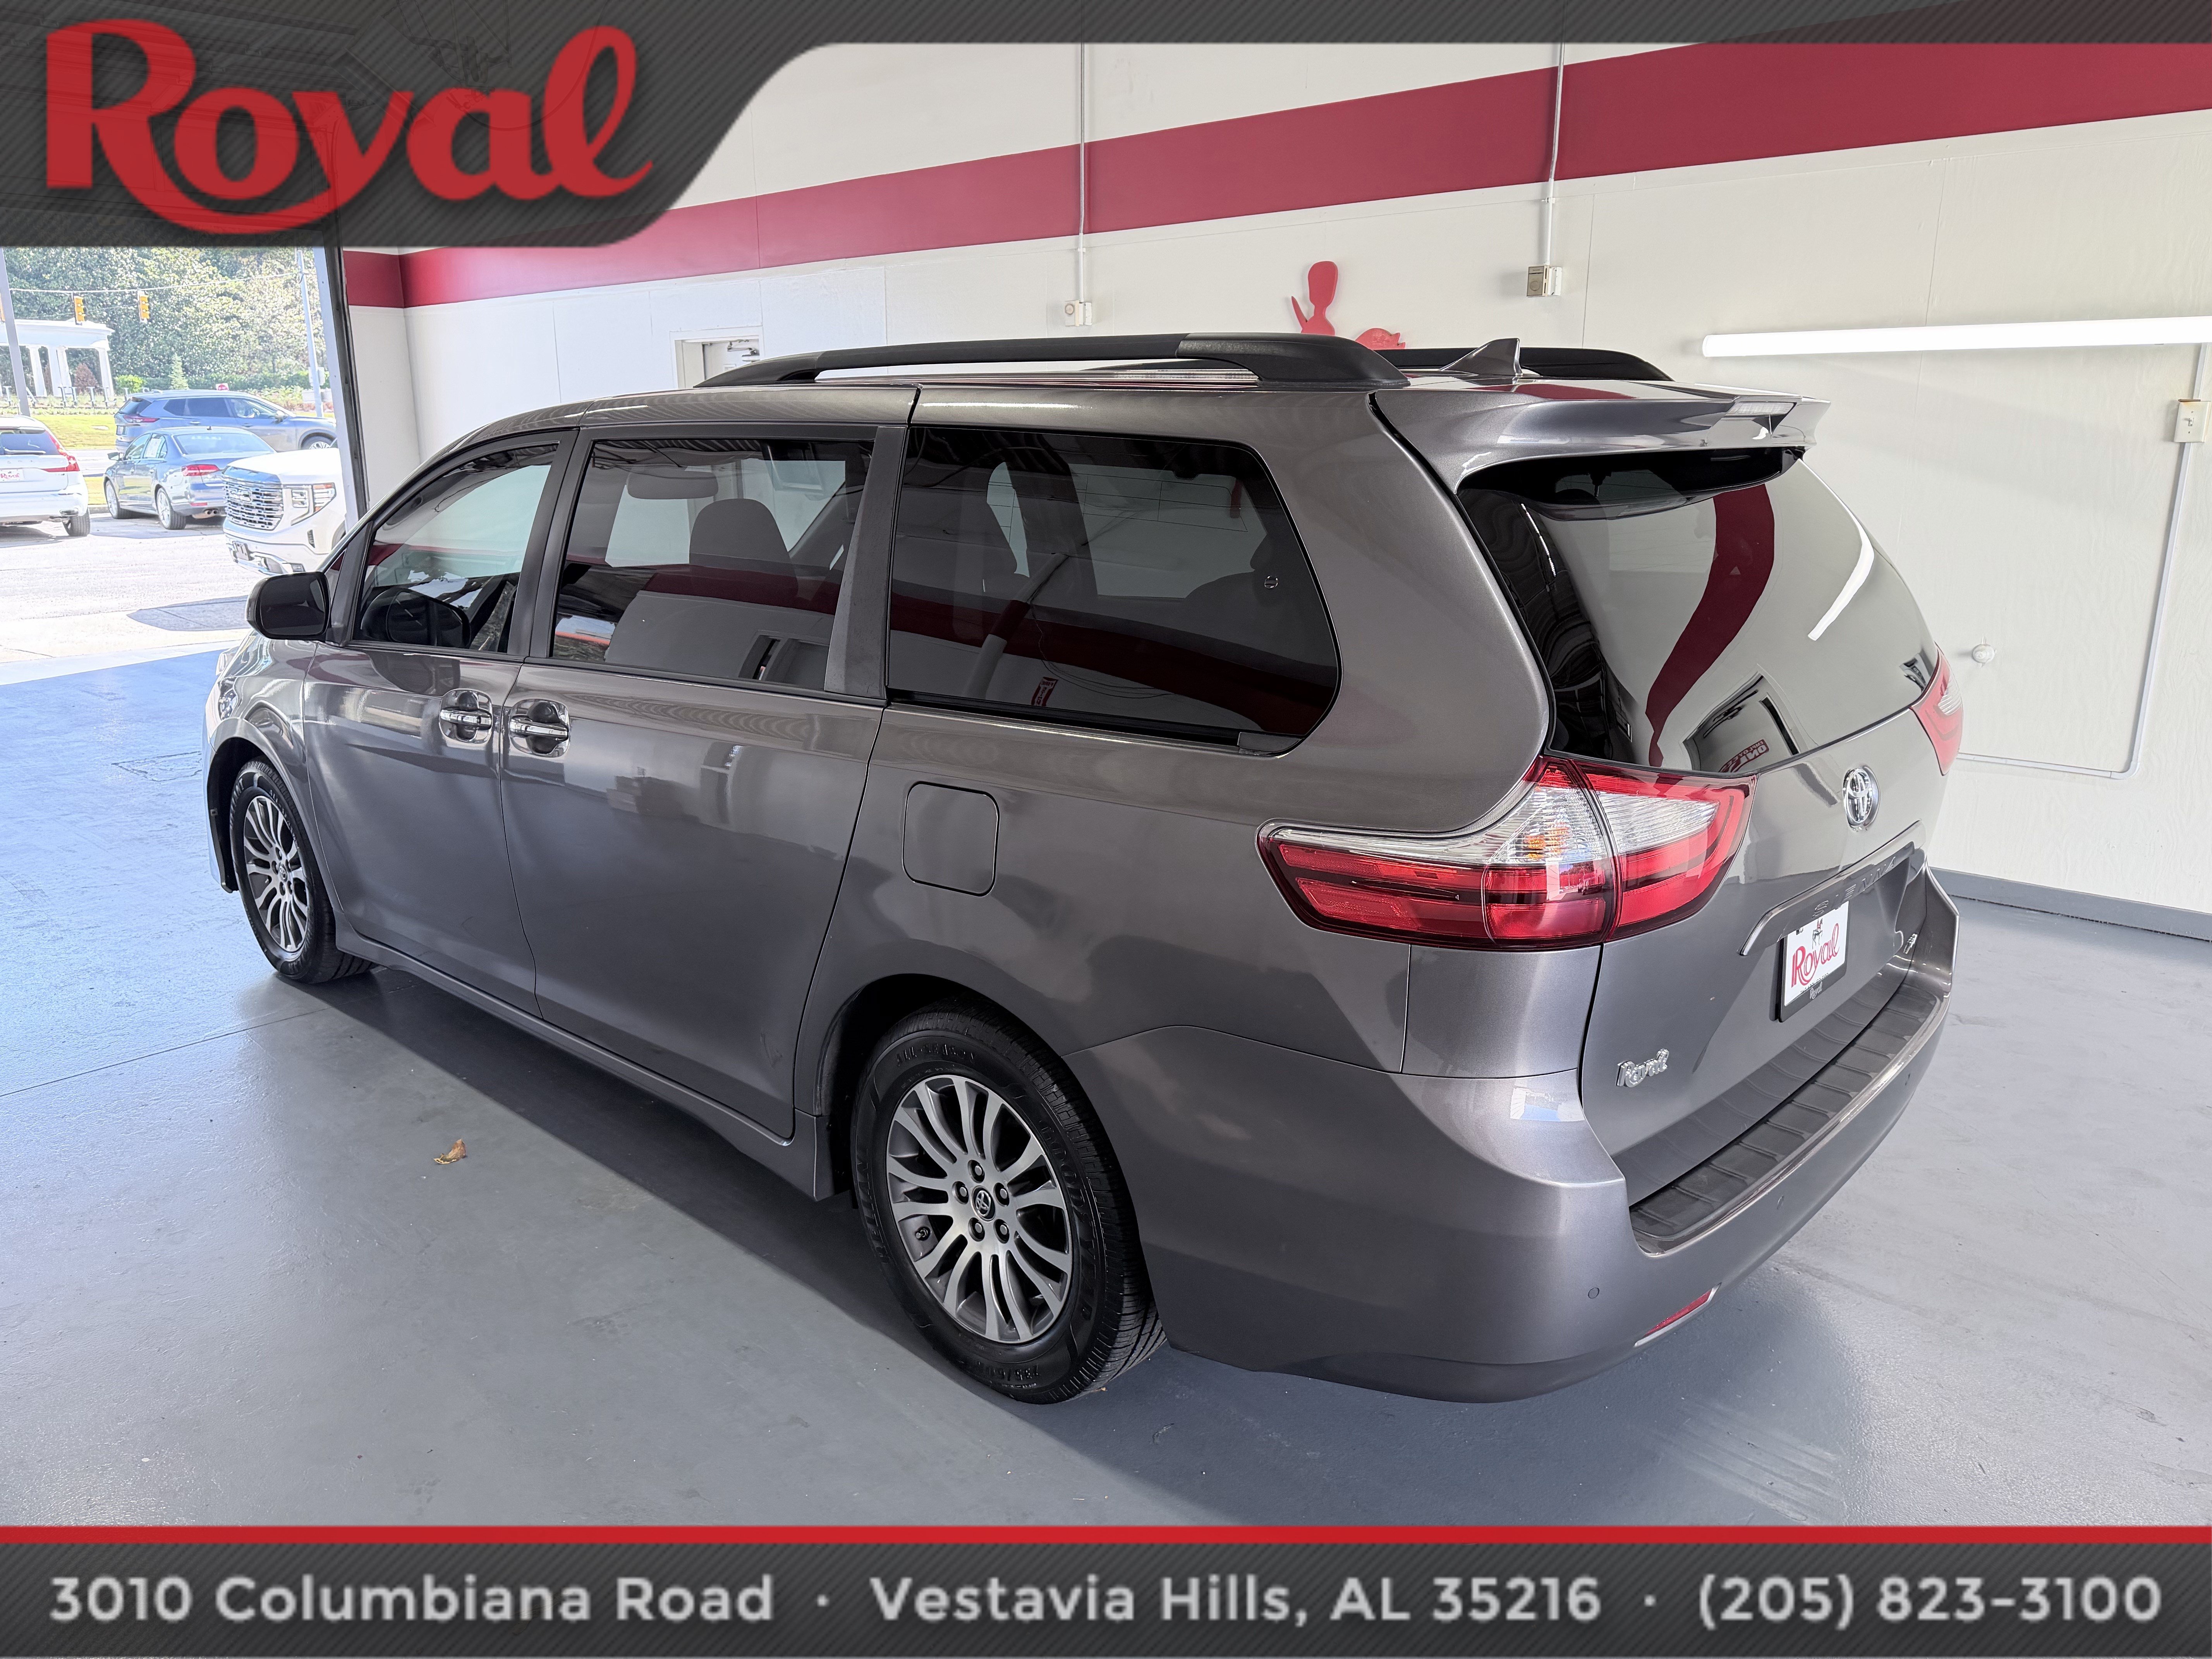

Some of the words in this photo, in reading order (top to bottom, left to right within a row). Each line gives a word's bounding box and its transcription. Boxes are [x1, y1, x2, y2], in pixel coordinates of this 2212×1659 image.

[1812, 856, 1896, 918] SIENNA
[1791, 923, 1840, 988] Royal
[1809, 981, 1823, 999] Royal
[1615, 1048, 1669, 1087] Royal
